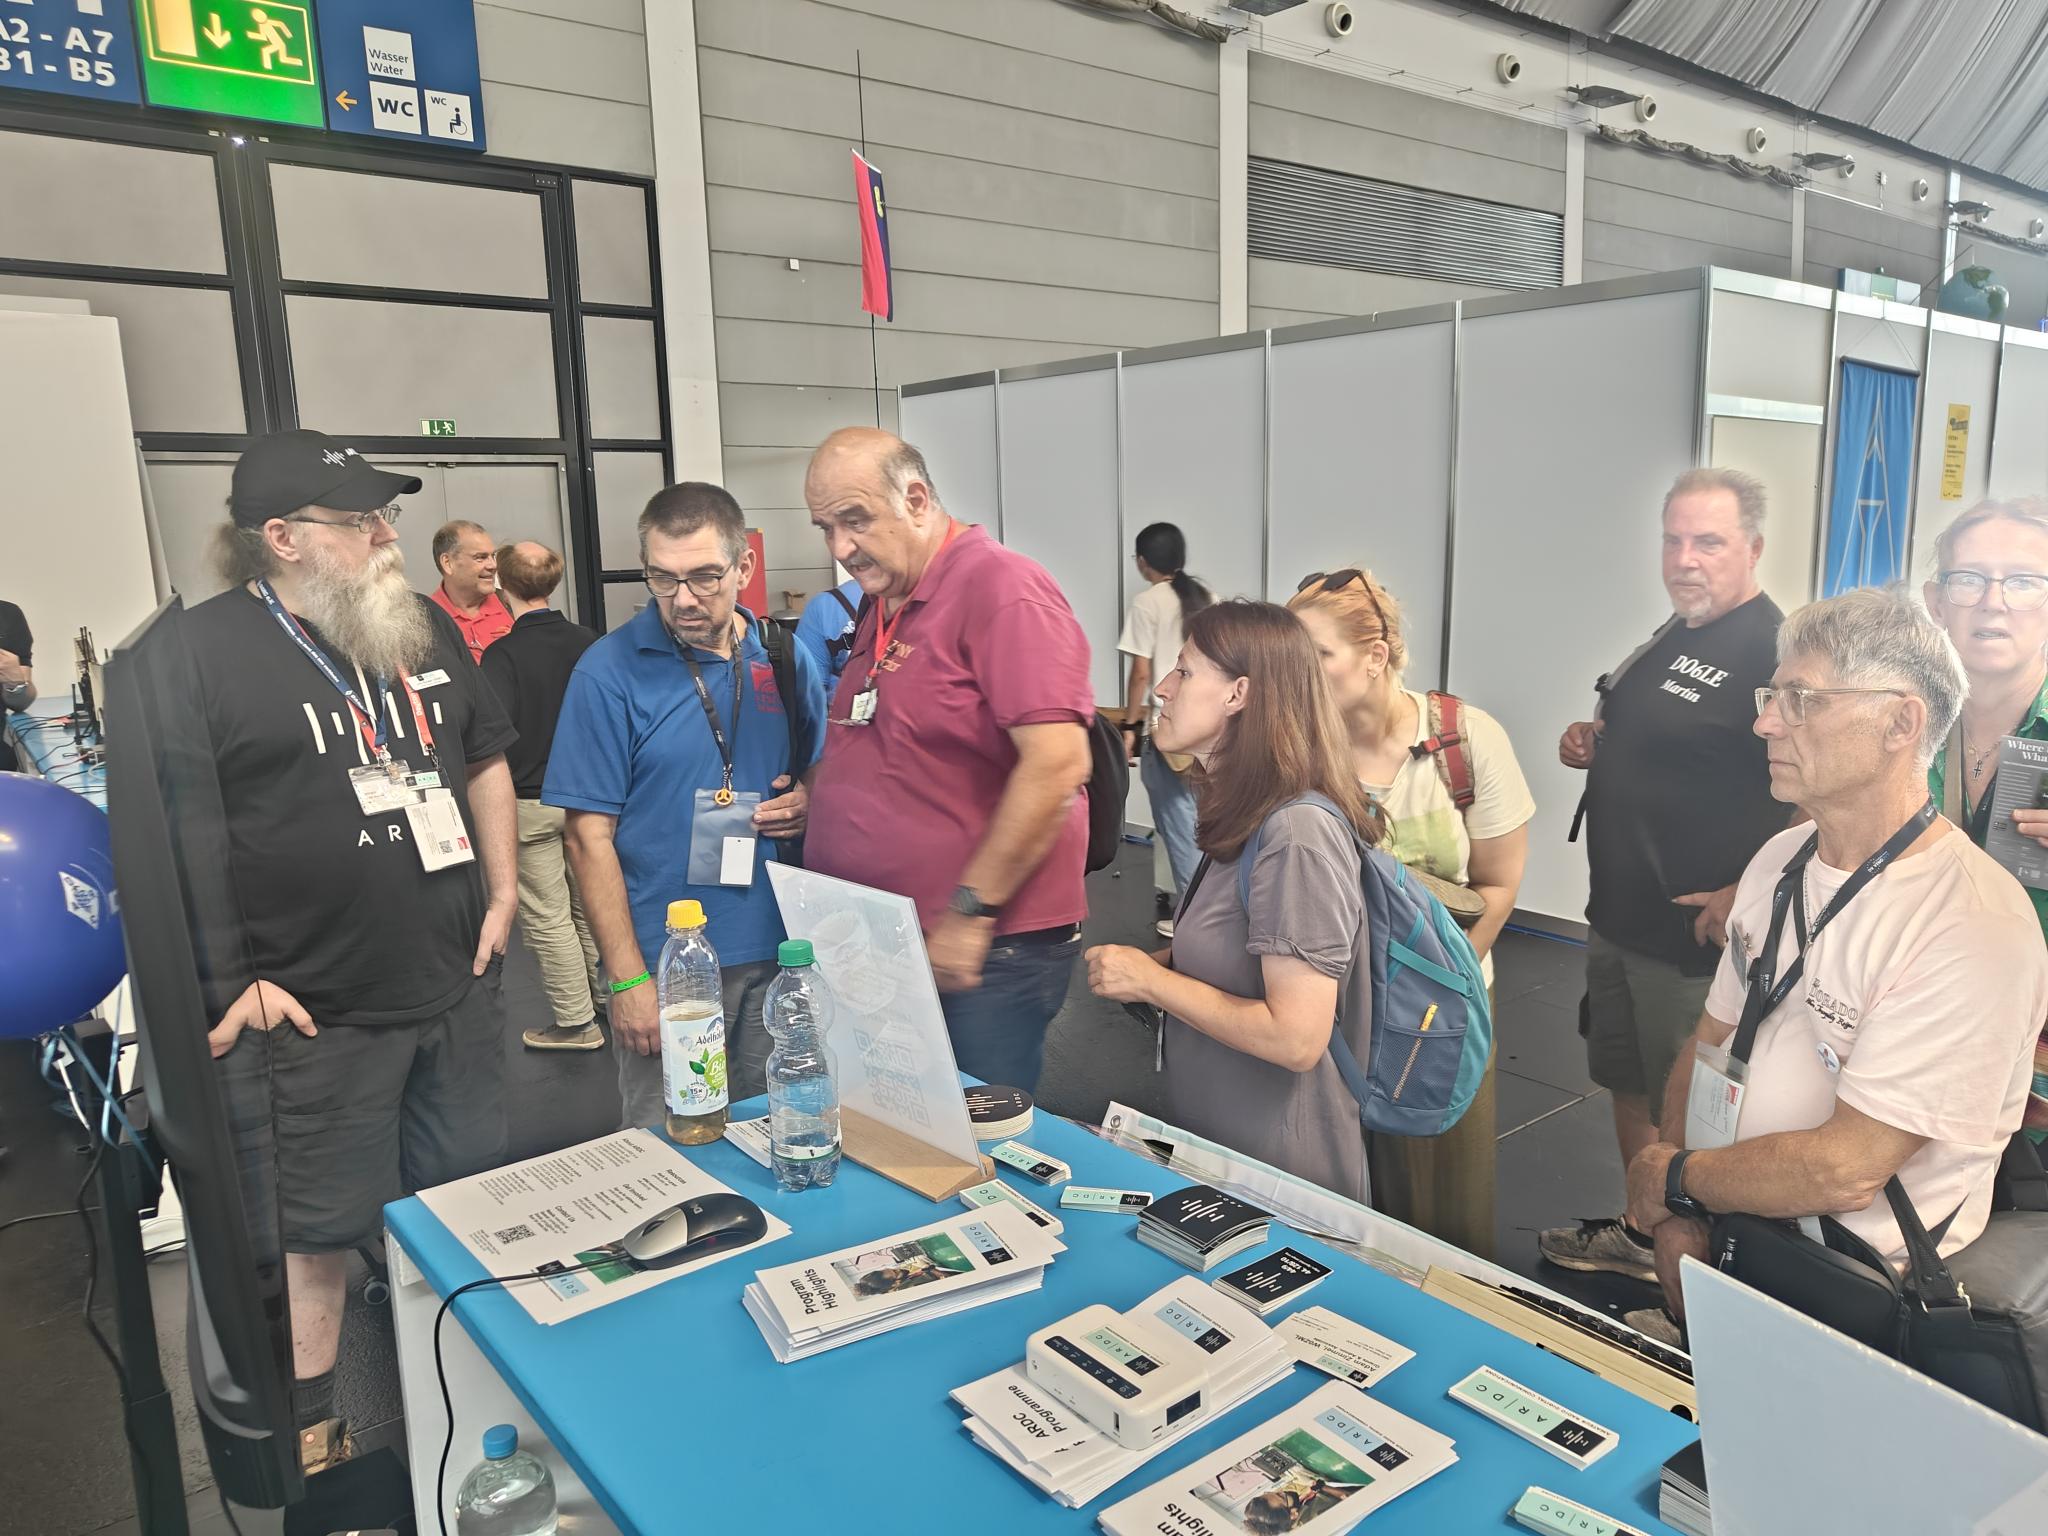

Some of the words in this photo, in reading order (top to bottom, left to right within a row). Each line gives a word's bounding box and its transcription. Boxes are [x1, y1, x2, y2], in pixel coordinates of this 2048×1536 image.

[40, 34, 53, 42] -
[65, 27, 114, 55] A7
[368, 48, 409, 65] Wasser
[44, 65, 58, 73] -
[69, 57, 116, 87] B5
[370, 61, 403, 77] Water
[377, 97, 414, 118] WC
[431, 96, 447, 107] WC
[1669, 655, 1729, 688] DO6LE
[1660, 680, 1702, 704] Martin
[2008, 739, 2045, 752] Where
[1809, 987, 1859, 1021] DORADO
[710, 1058, 726, 1076] Bio
[1013, 1092, 1024, 1108] ARDC
[663, 1168, 689, 1184] Resources
[629, 1189, 648, 1201] Involved
[553, 1205, 572, 1218] Contact
[970, 1225, 993, 1248] ARDC
[790, 1278, 820, 1315] Program
[804, 1268, 839, 1310] Highlights
[1166, 1308, 1202, 1333] ARDC
[1095, 1334, 1132, 1358] ARDC
[1351, 1358, 1377, 1373] Adam
[1481, 1366, 1539, 1399] COMMUNICATIONS
[1008, 1385, 1069, 1434] Programme
[1473, 1382, 1549, 1424] ARDC
[1535, 1393, 1564, 1412] DIGITAL
[1559, 1406, 1584, 1422] RADIO
[1013, 1412, 1050, 1439] ARDC
[1325, 1414, 1373, 1445] ARDC
[1580, 1417, 1616, 1438] AMATEUR
[1537, 1500, 1607, 1534] ARDC
